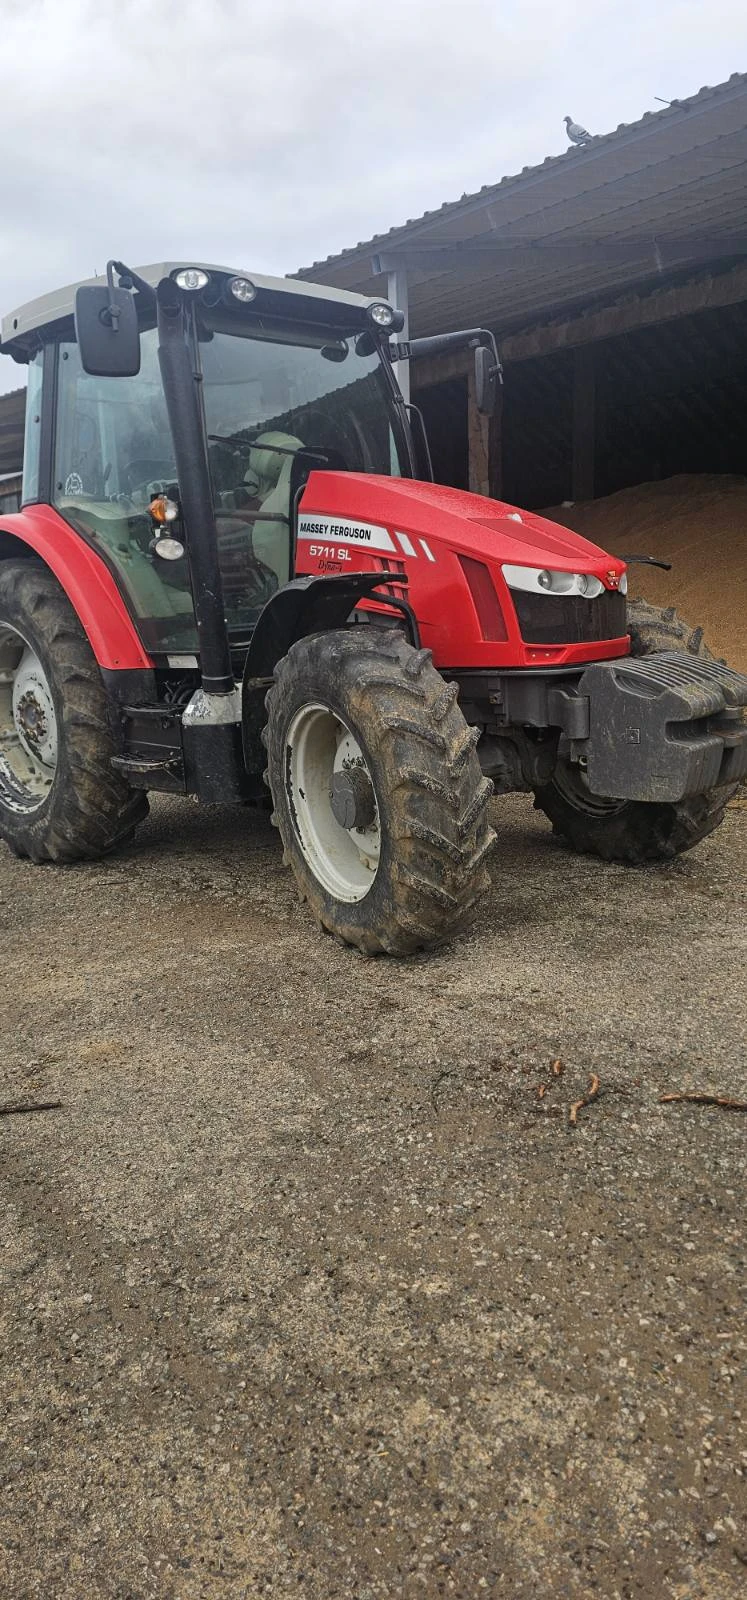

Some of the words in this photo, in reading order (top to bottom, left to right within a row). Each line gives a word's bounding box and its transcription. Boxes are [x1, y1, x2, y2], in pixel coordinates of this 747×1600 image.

[300, 523, 328, 534] MASSEY
[330, 525, 371, 540] FERGUSON
[309, 545, 335, 558] 5711
[337, 550, 352, 560] SL
